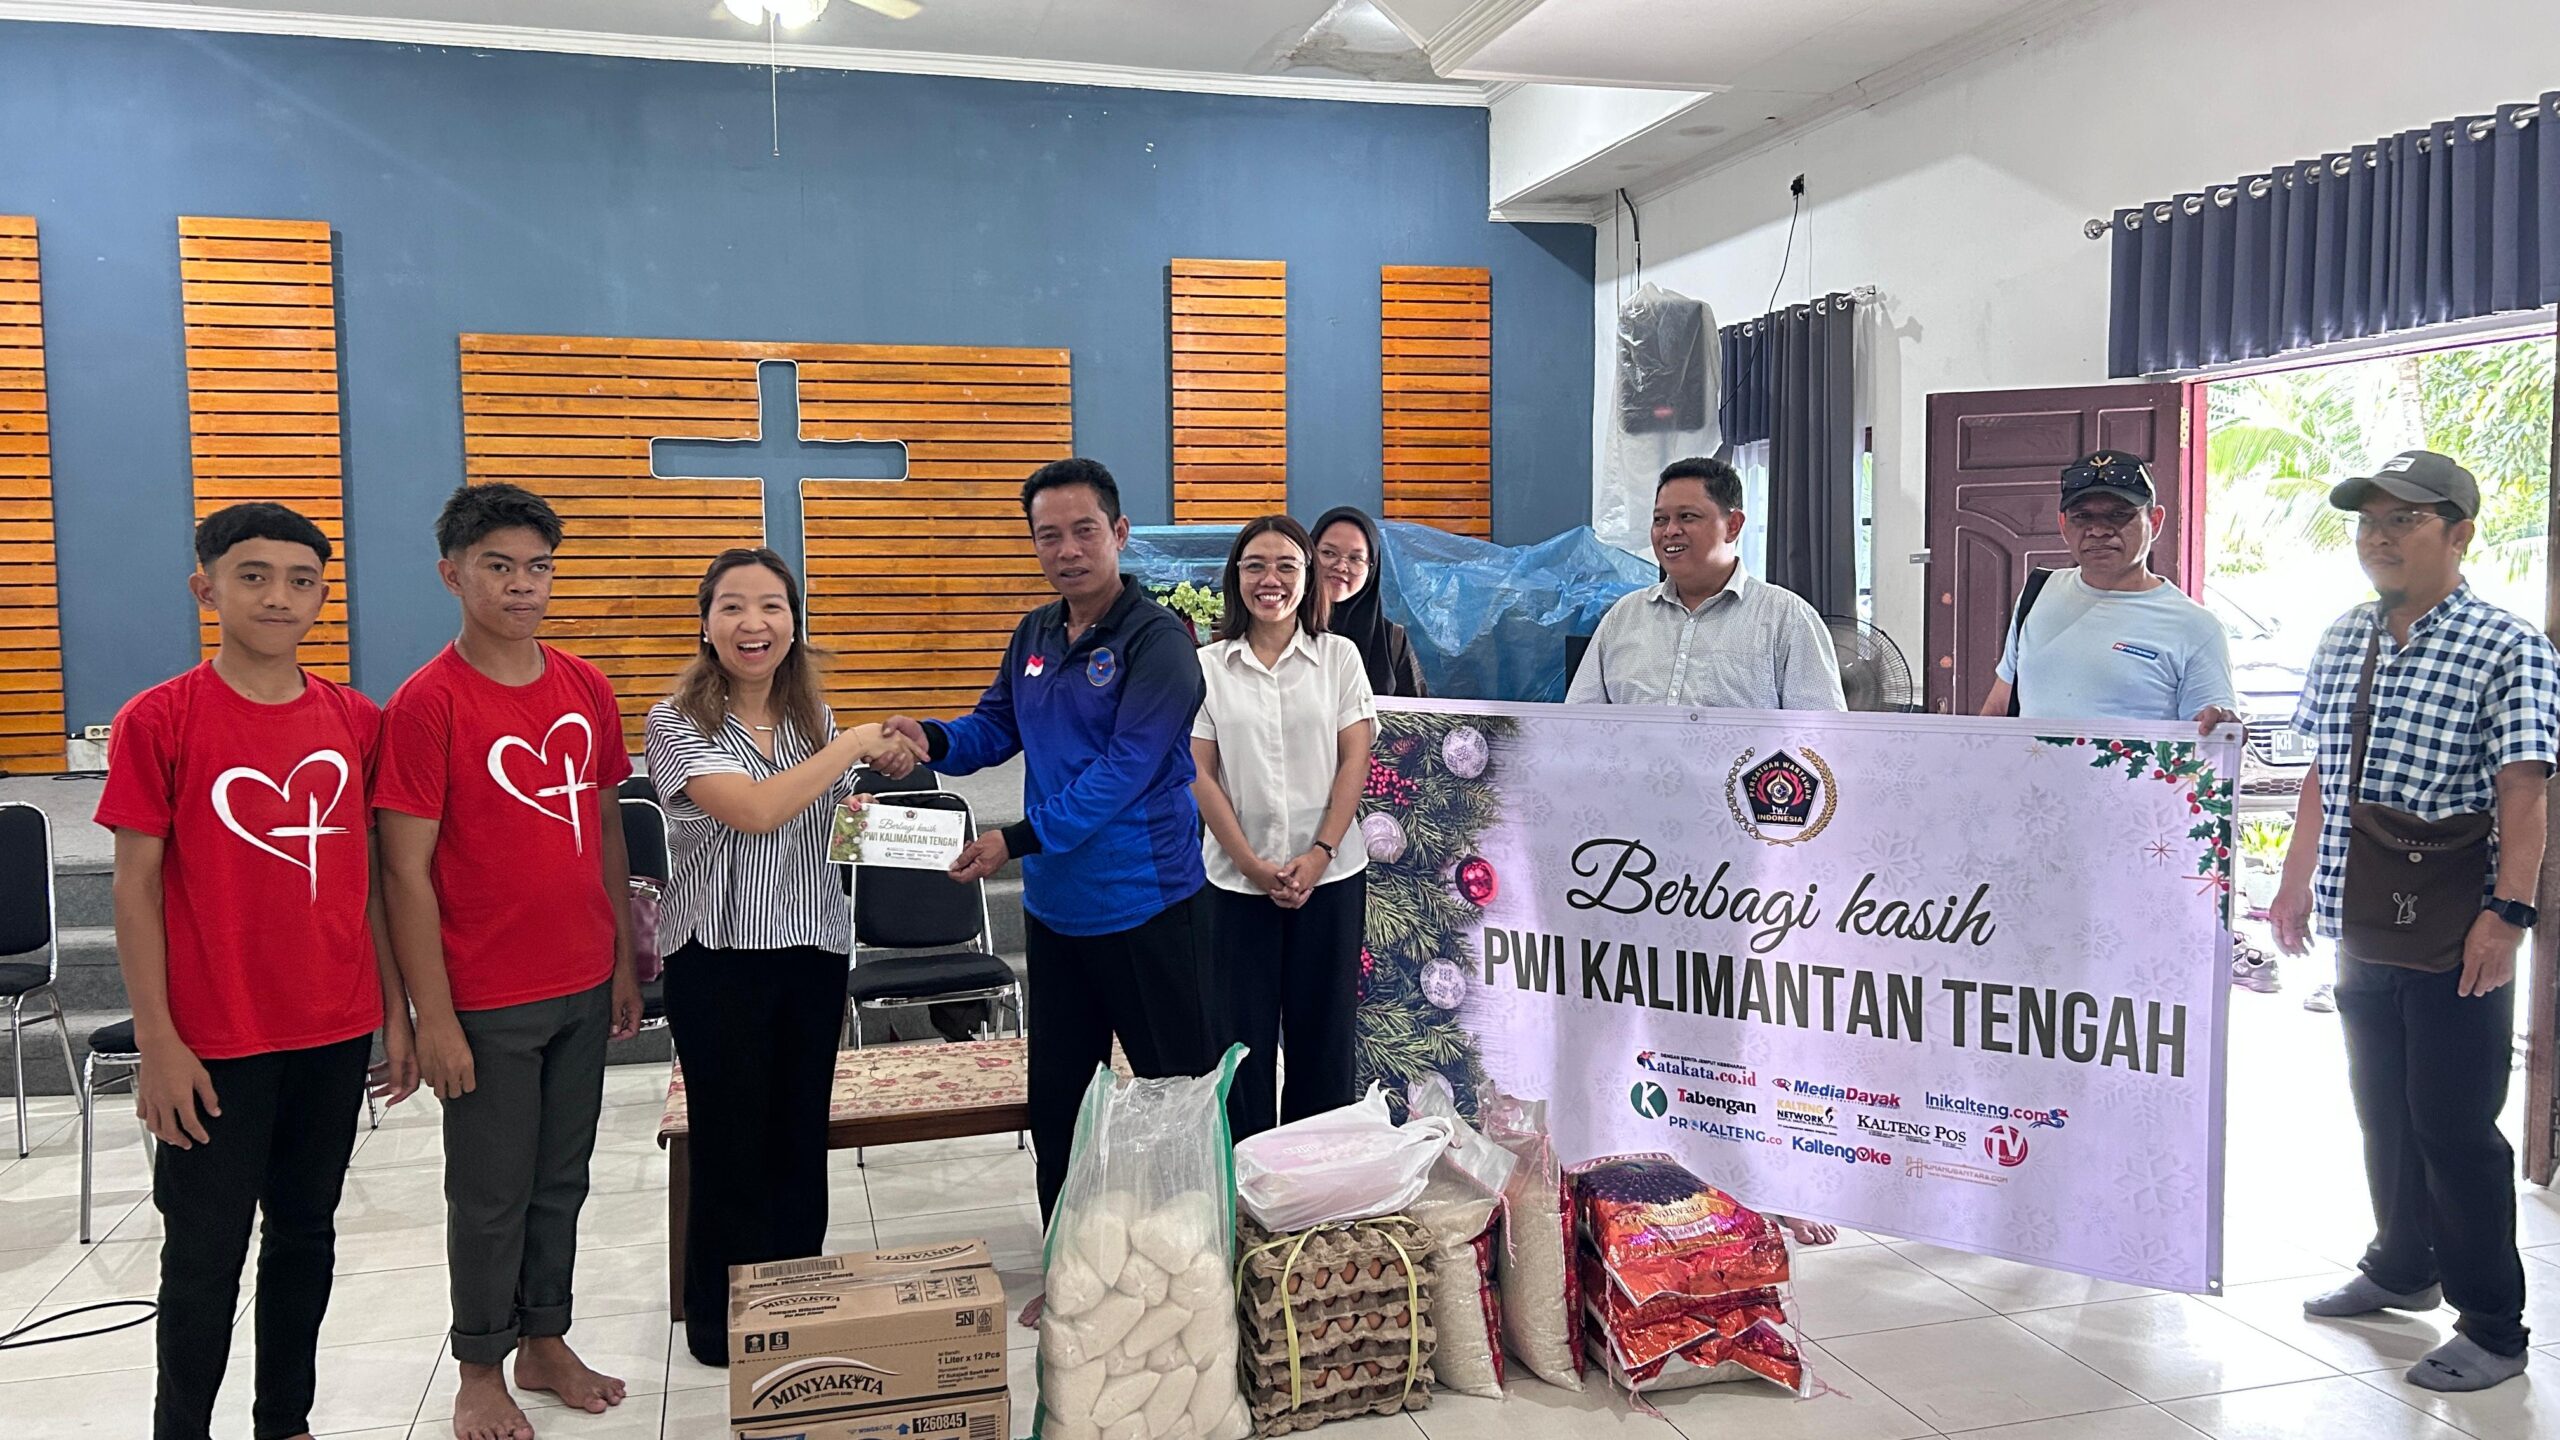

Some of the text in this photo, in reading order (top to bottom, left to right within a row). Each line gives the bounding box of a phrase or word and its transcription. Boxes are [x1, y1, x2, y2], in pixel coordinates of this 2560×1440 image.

[1749, 761, 1812, 800] PERSATUAN WARTAWAN
[880, 818, 915, 834] Berbagi
[1757, 814, 1803, 823] INDONESIA
[863, 831, 958, 847] PWI KALIMANTAN TENGAH
[1566, 838, 1996, 954] Berbagi kasih
[1483, 926, 2186, 1078] PWI KALIMANTAN TENGAH
[1677, 1088, 1757, 1115] Tabengan
[1777, 1099, 1824, 1115] KALTENG
[1777, 1109, 1824, 1124] NETWORK
[1857, 1114, 1931, 1137] KALTENG
[1792, 1135, 1892, 1165] KaltengOke
[955, 1310, 975, 1327] SNI
[775, 1333, 784, 1345] 6
[945, 1355, 964, 1364] Liter
[974, 1352, 983, 1360] 12
[985, 1351, 1001, 1359] Pcs
[769, 1373, 884, 1410] MINYAKITA
[916, 1413, 963, 1431] 1260845
